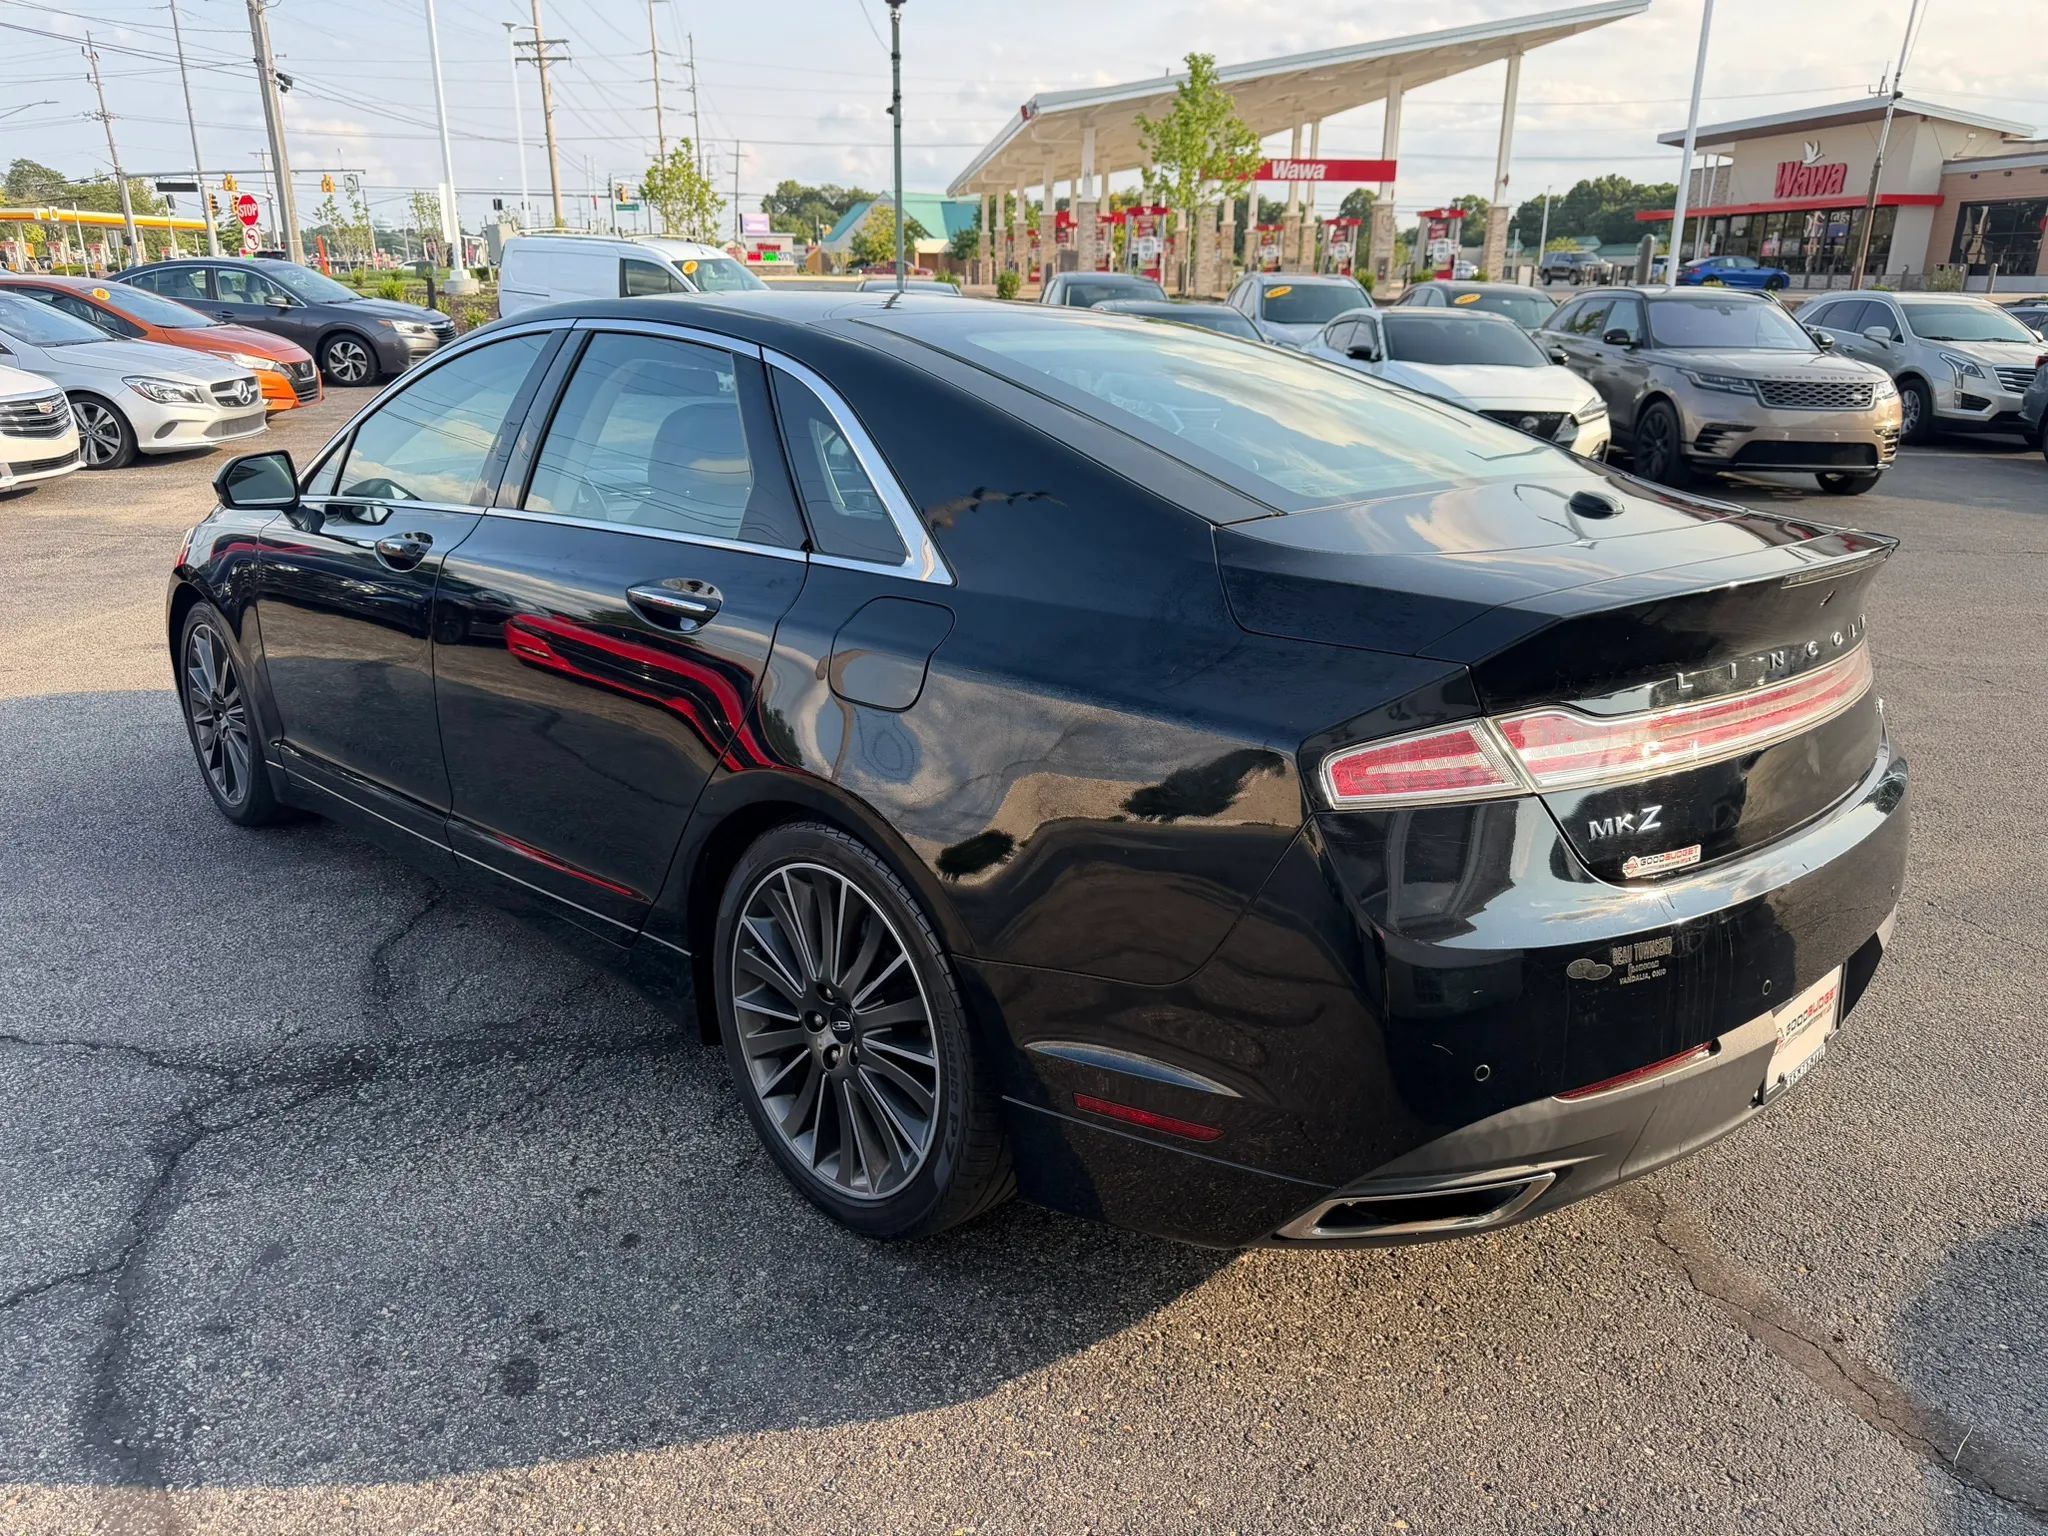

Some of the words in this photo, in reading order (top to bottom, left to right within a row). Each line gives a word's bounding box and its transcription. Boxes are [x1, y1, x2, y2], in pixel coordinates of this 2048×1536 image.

[1271, 160, 1327, 180] Wawa
[1774, 160, 1848, 198] Wawa
[239, 203, 258, 218] STOP
[1676, 613, 1866, 691] LINCOLN
[1588, 805, 1663, 840] MKZ
[1612, 944, 1633, 966] BEAU
